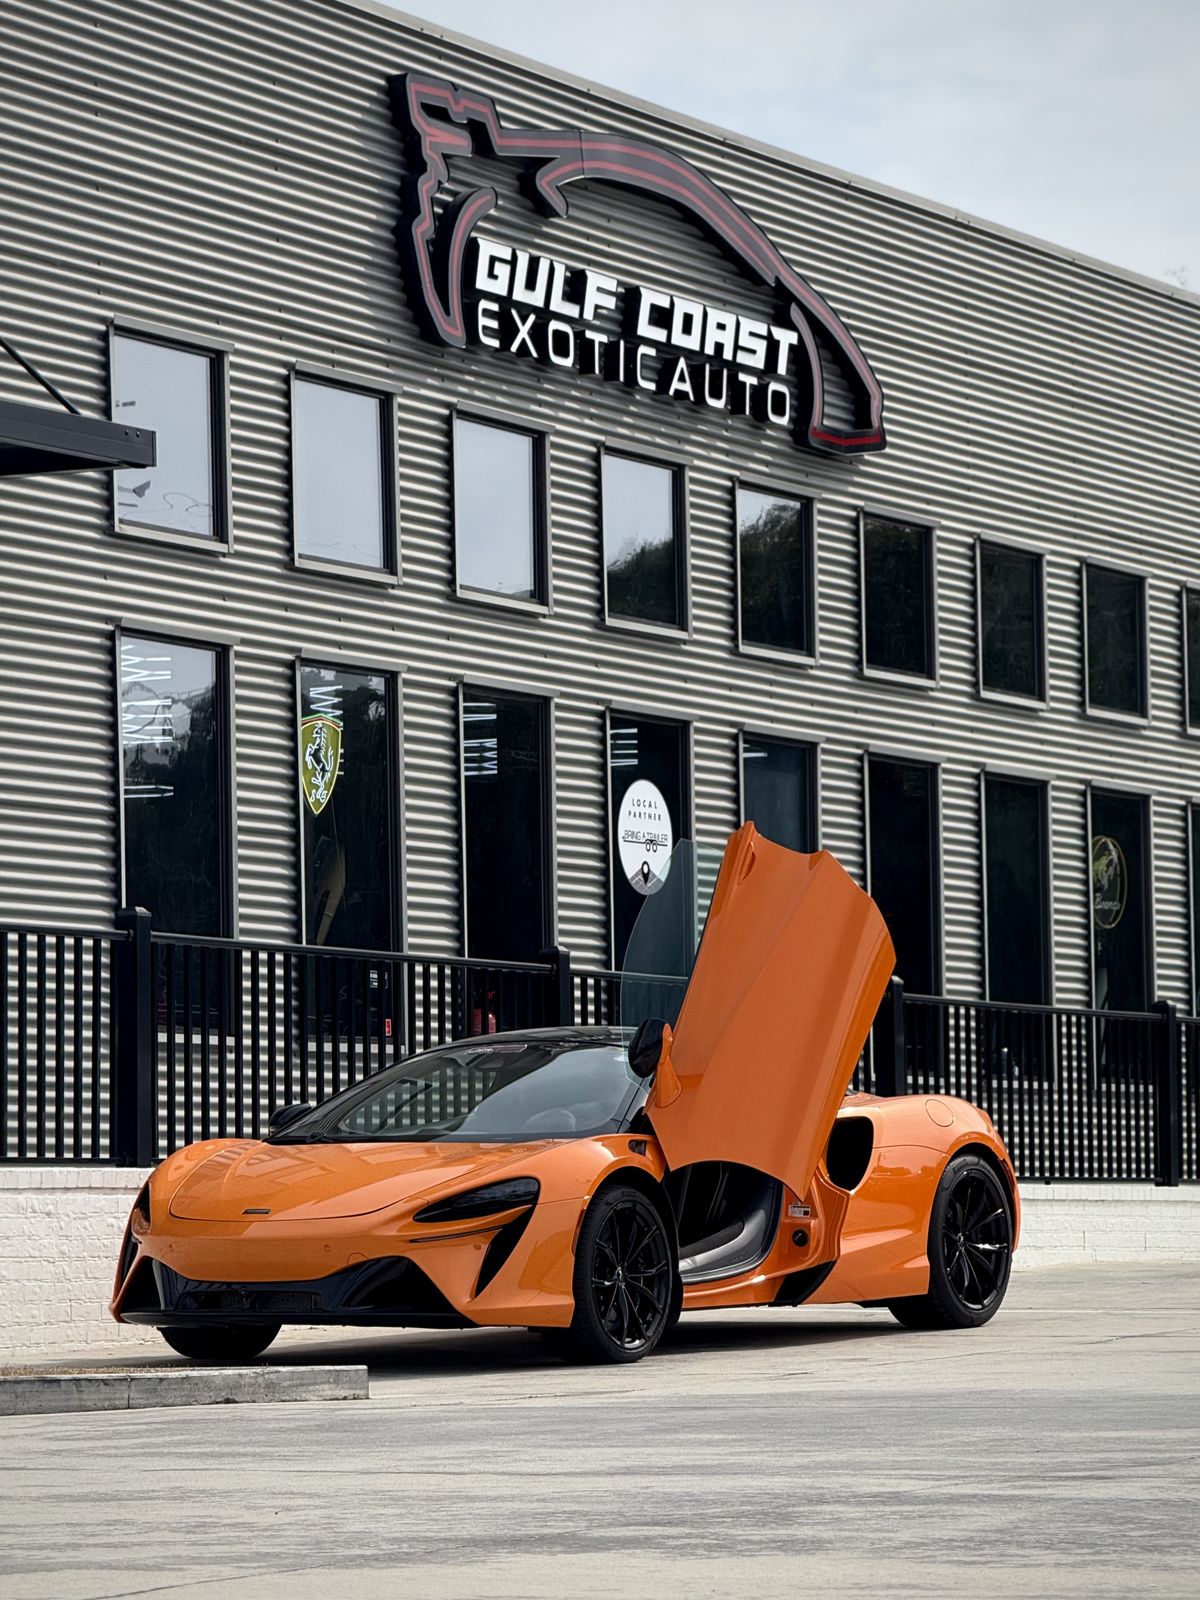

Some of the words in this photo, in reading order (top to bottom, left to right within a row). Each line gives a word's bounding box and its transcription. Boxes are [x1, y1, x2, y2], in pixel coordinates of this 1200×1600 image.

[476, 237, 617, 321] GULF
[637, 286, 798, 376] COAST
[632, 798, 657, 809] LOCAL
[628, 810, 661, 821] PARTNER
[624, 829, 641, 841] BRING
